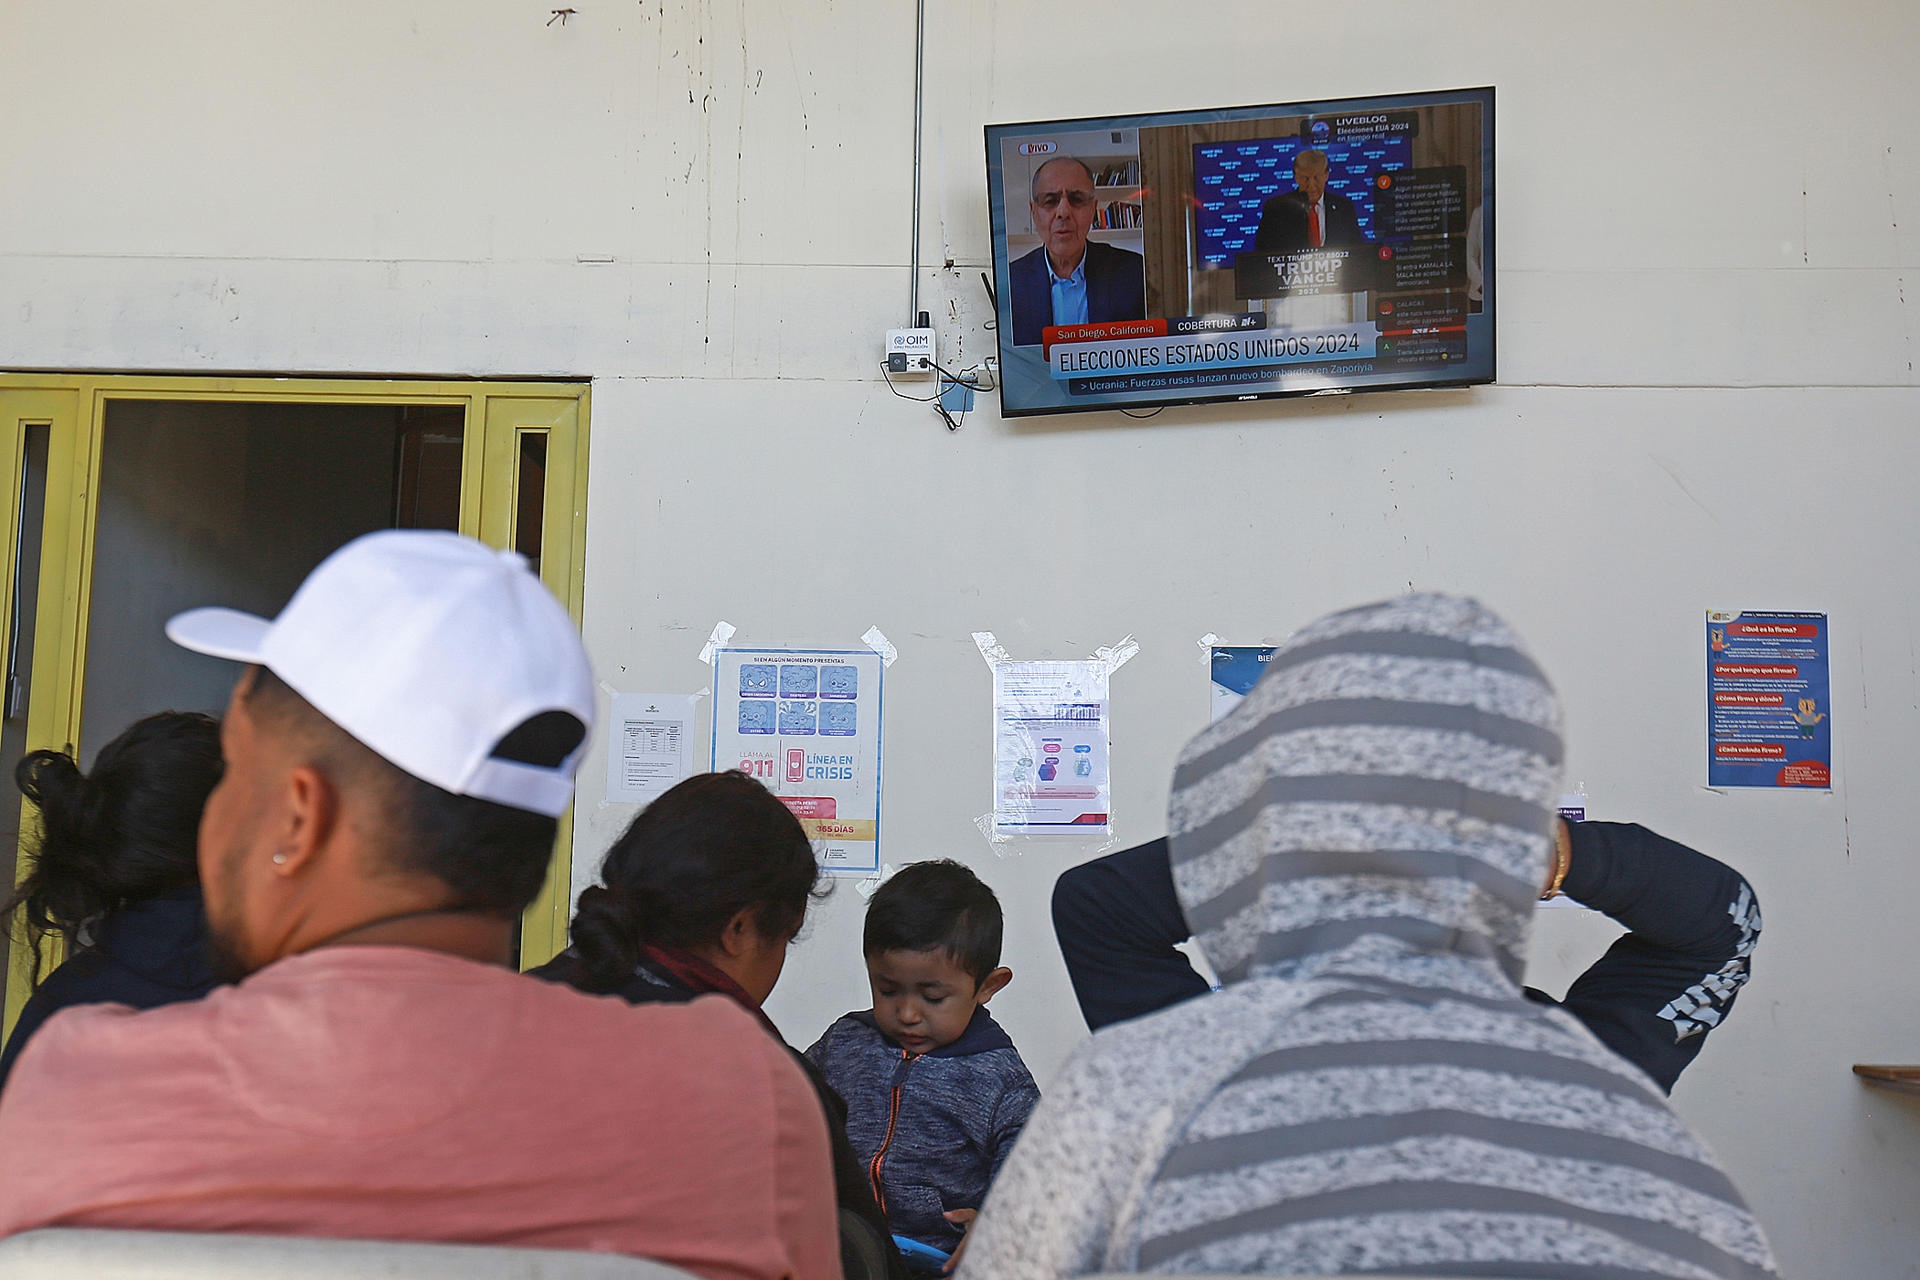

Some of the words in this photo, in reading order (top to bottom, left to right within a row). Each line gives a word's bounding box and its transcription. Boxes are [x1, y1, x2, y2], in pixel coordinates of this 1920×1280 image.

[1336, 115, 1387, 126] LIVEBLOG
[1337, 125, 1373, 135] Elecciones
[1375, 123, 1389, 132] EUA
[1391, 122, 1409, 131] 2024
[1267, 255, 1285, 263] TEXT
[1274, 259, 1343, 276] TRUMP
[1282, 271, 1336, 286] VANCE
[1298, 288, 1319, 296] 2024
[1178, 318, 1237, 331] COBERTURA
[1057, 330, 1076, 340] San
[1110, 324, 1154, 336] California
[906, 335, 928, 345] OIM
[1060, 347, 1160, 372] ELECCIONES
[1166, 341, 1239, 365] ESTADOS
[1245, 336, 1310, 359] UNIDOS
[1315, 333, 1360, 354] 2024
[1090, 379, 1127, 391] Ucrania:
[1131, 376, 1166, 388] Fuerzas
[1168, 375, 1194, 385] rusas
[1197, 372, 1227, 384] lanzan
[1230, 370, 1258, 381] nuevo
[1260, 367, 1314, 379] bombardeo
[1316, 366, 1328, 374] en
[807, 752, 838, 765] LÍNEA
[840, 756, 853, 765] EN
[740, 760, 774, 778] 911
[806, 766, 853, 780] CRISIS
[816, 825, 833, 833] 365
[834, 824, 855, 834] DÍAS
